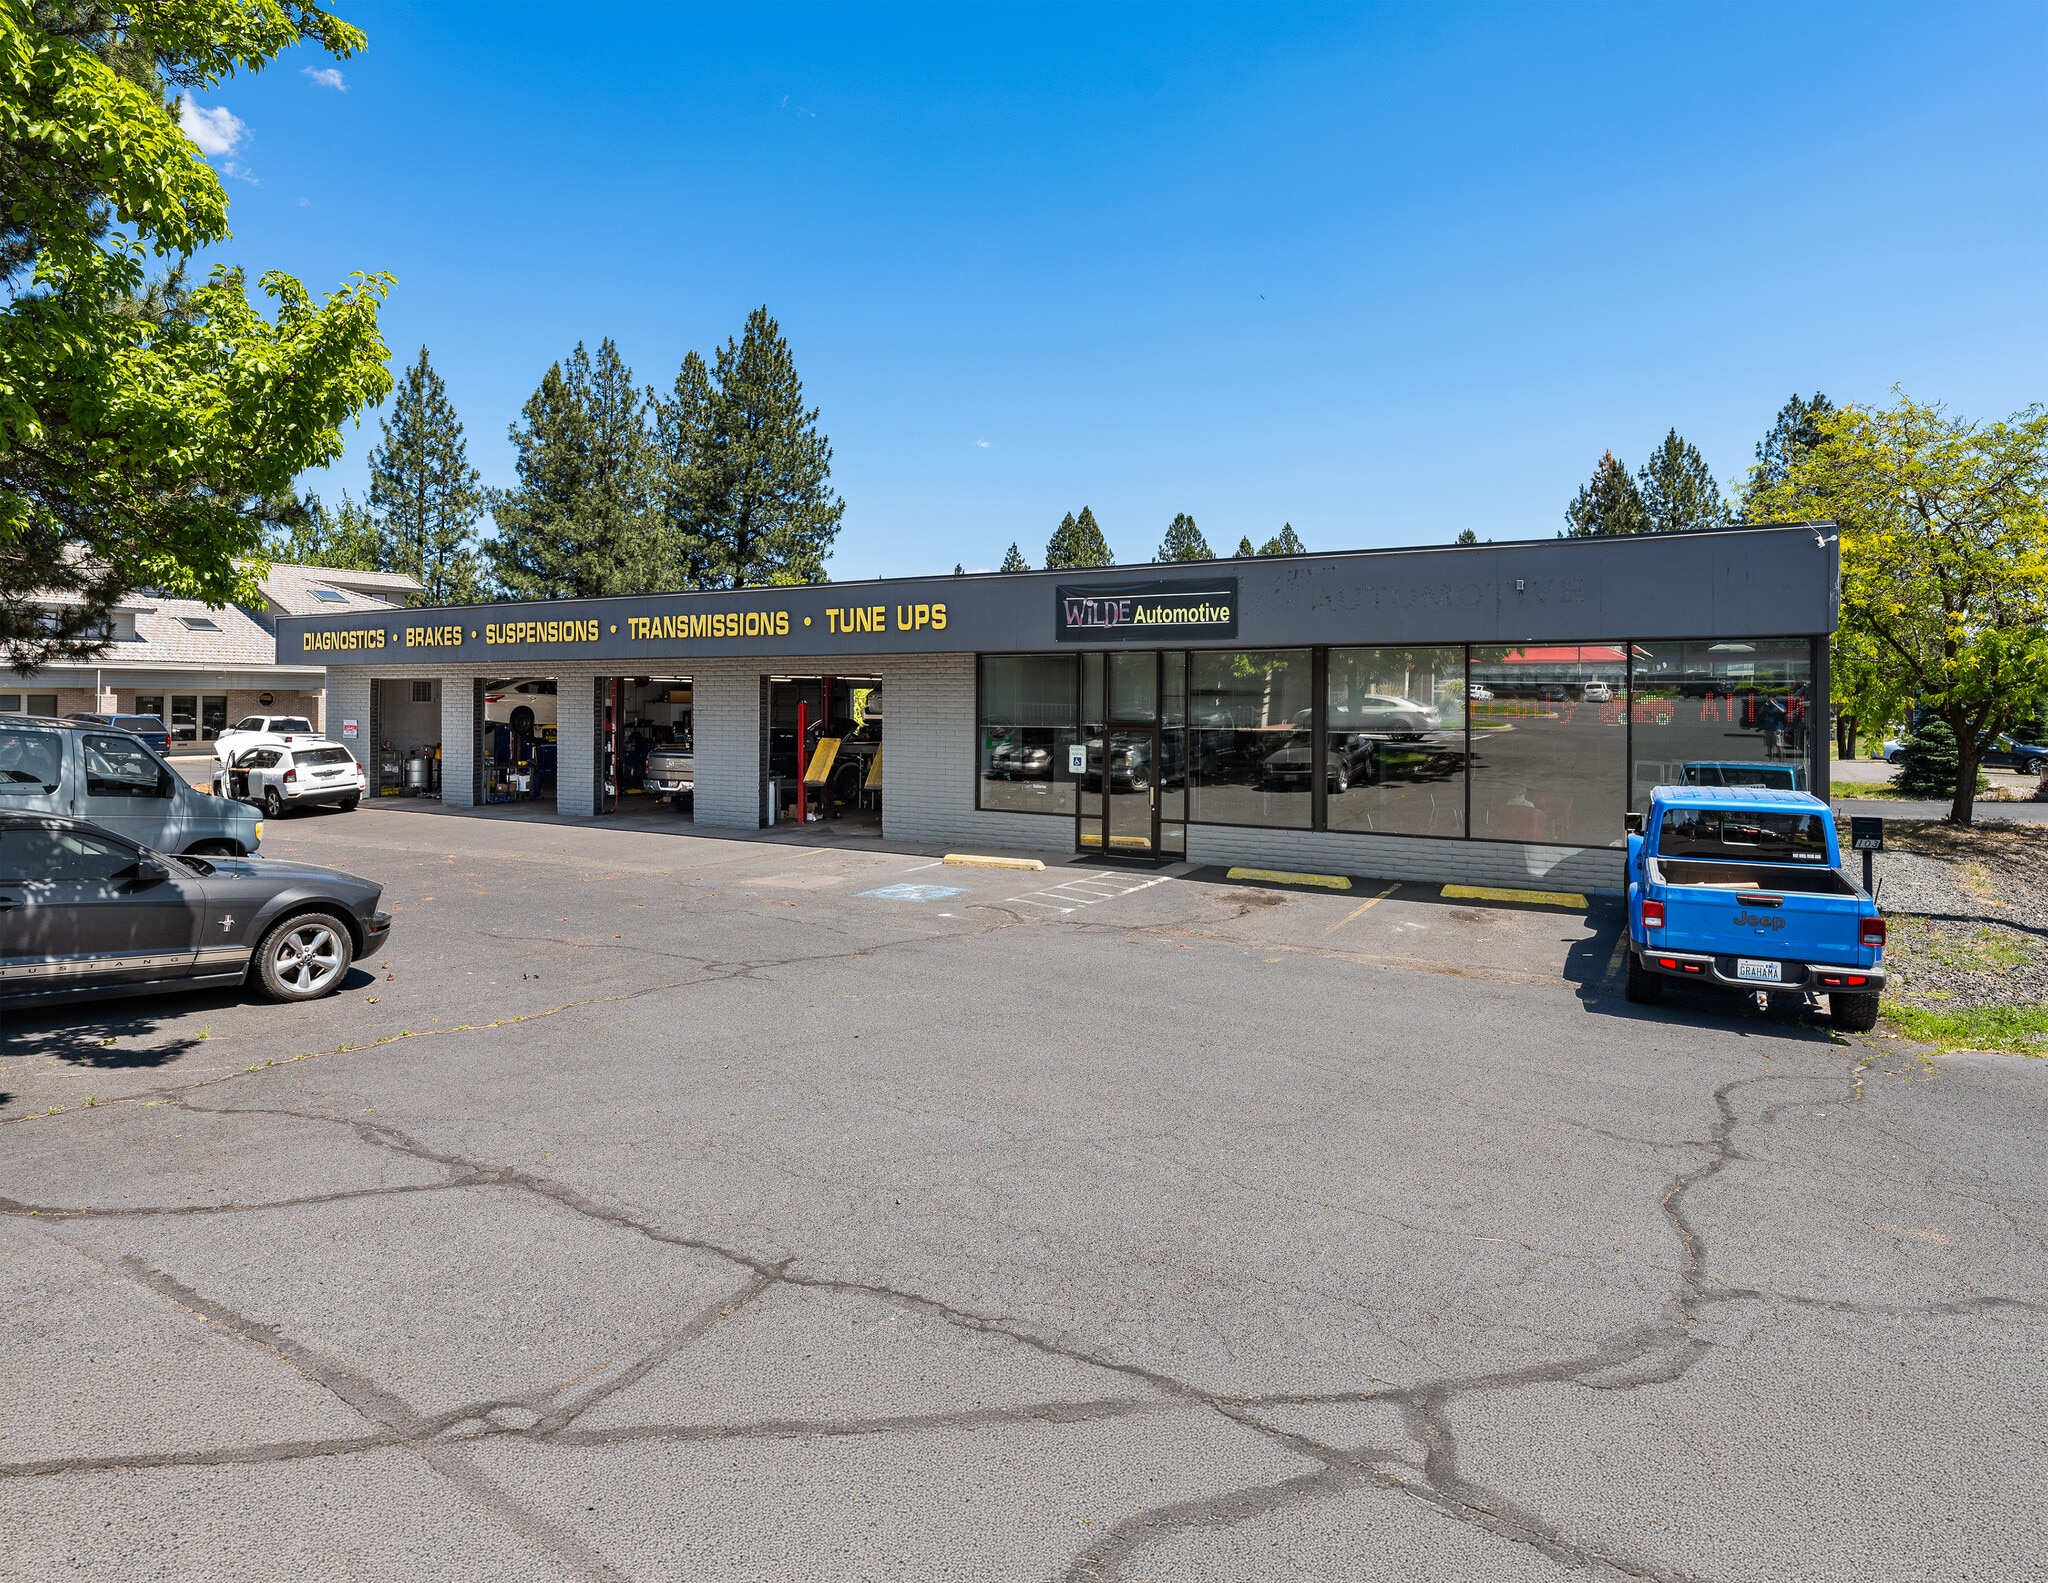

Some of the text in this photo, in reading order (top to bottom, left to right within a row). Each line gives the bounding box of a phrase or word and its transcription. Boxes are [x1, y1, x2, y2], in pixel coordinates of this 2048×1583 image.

[1133, 602, 1230, 624] Automotive
[303, 603, 947, 651] DIAGNOSTICS BRAKES SUSPENSIONS TRANSMISSIONS TUNE UPS
[1859, 840, 1879, 848] 103
[1733, 911, 1786, 931] Jeep
[1740, 965, 1779, 979] GRAHAMA
